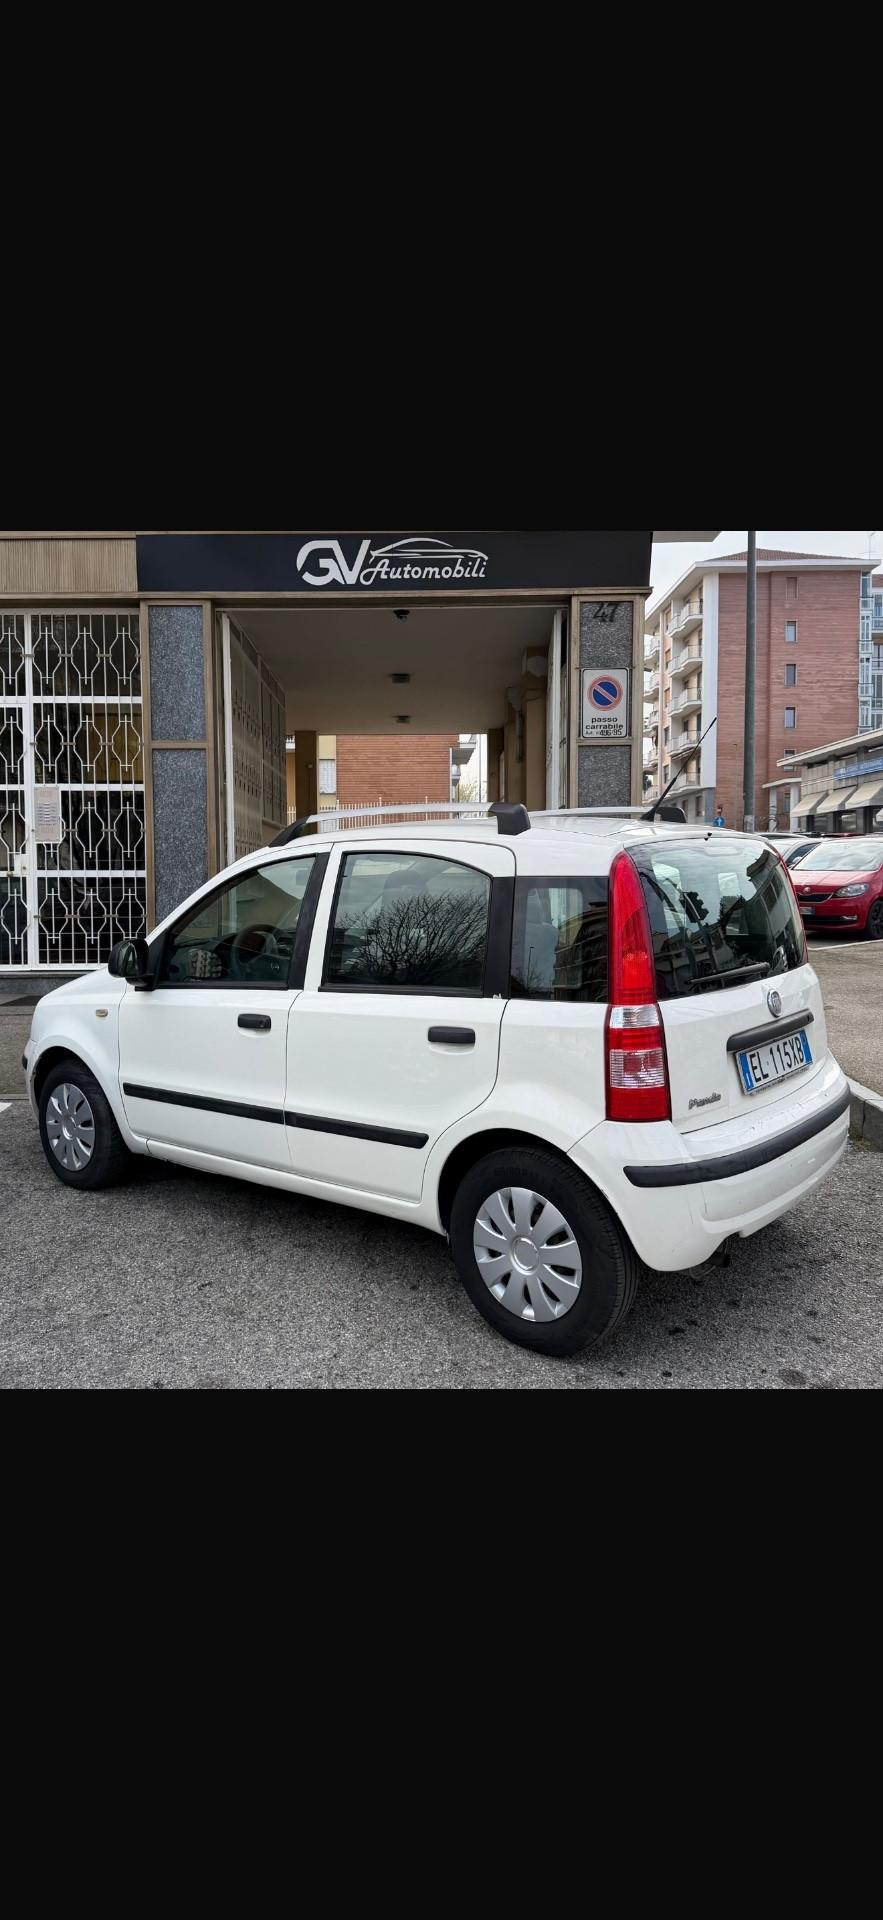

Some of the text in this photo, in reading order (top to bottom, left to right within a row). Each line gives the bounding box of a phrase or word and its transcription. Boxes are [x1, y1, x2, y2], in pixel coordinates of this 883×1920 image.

[296, 540, 487, 586] GV Automobili
[593, 601, 619, 622] 47
[749, 1051, 769, 1083] EL
[770, 1036, 805, 1075] 115XB
